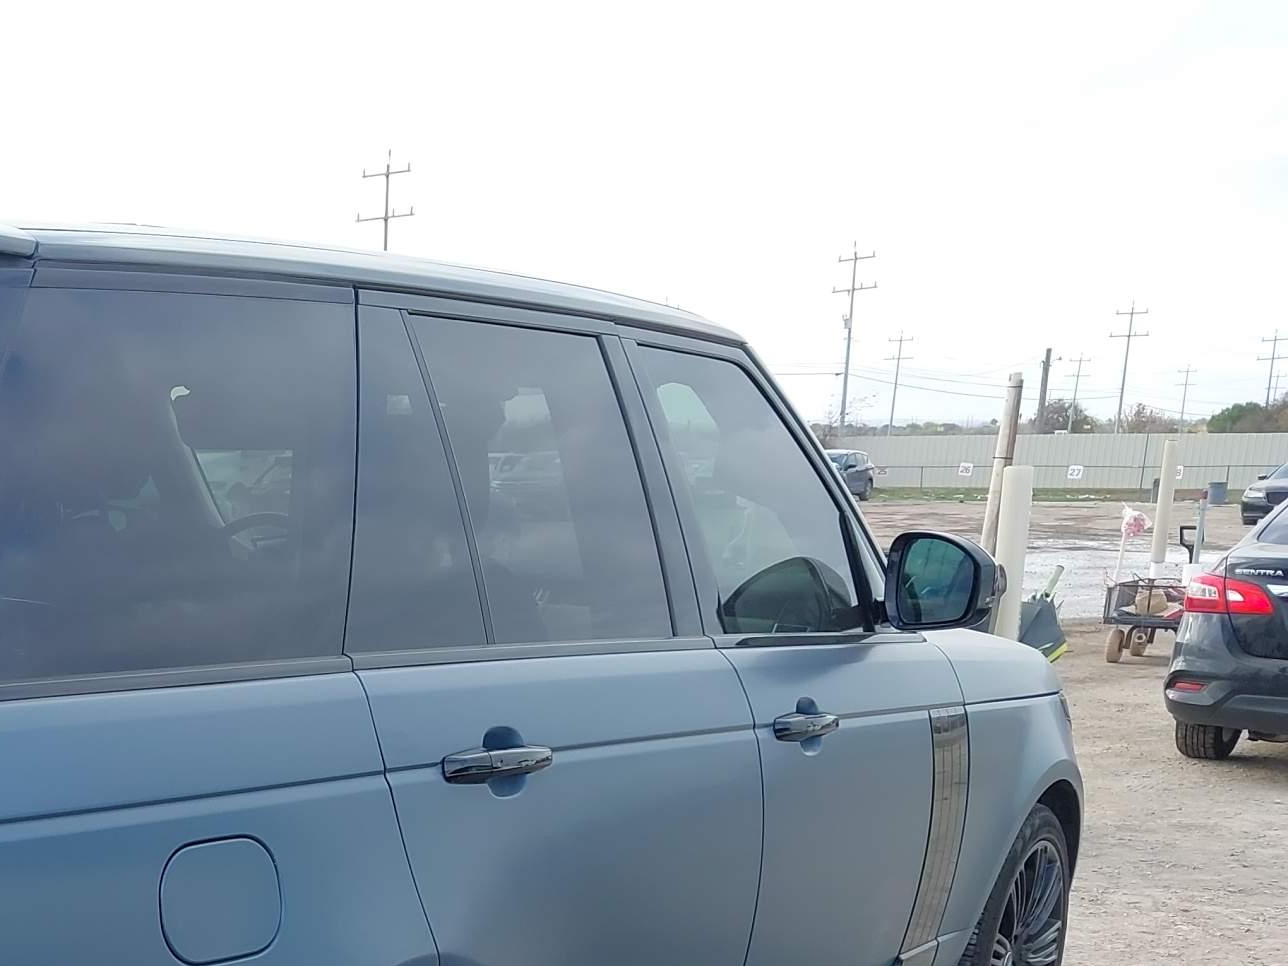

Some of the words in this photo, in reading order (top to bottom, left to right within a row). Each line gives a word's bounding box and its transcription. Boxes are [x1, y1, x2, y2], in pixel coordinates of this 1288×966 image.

[959, 465, 971, 474] 26
[1070, 468, 1082, 477] 27
[1234, 568, 1285, 577] SENTRA
